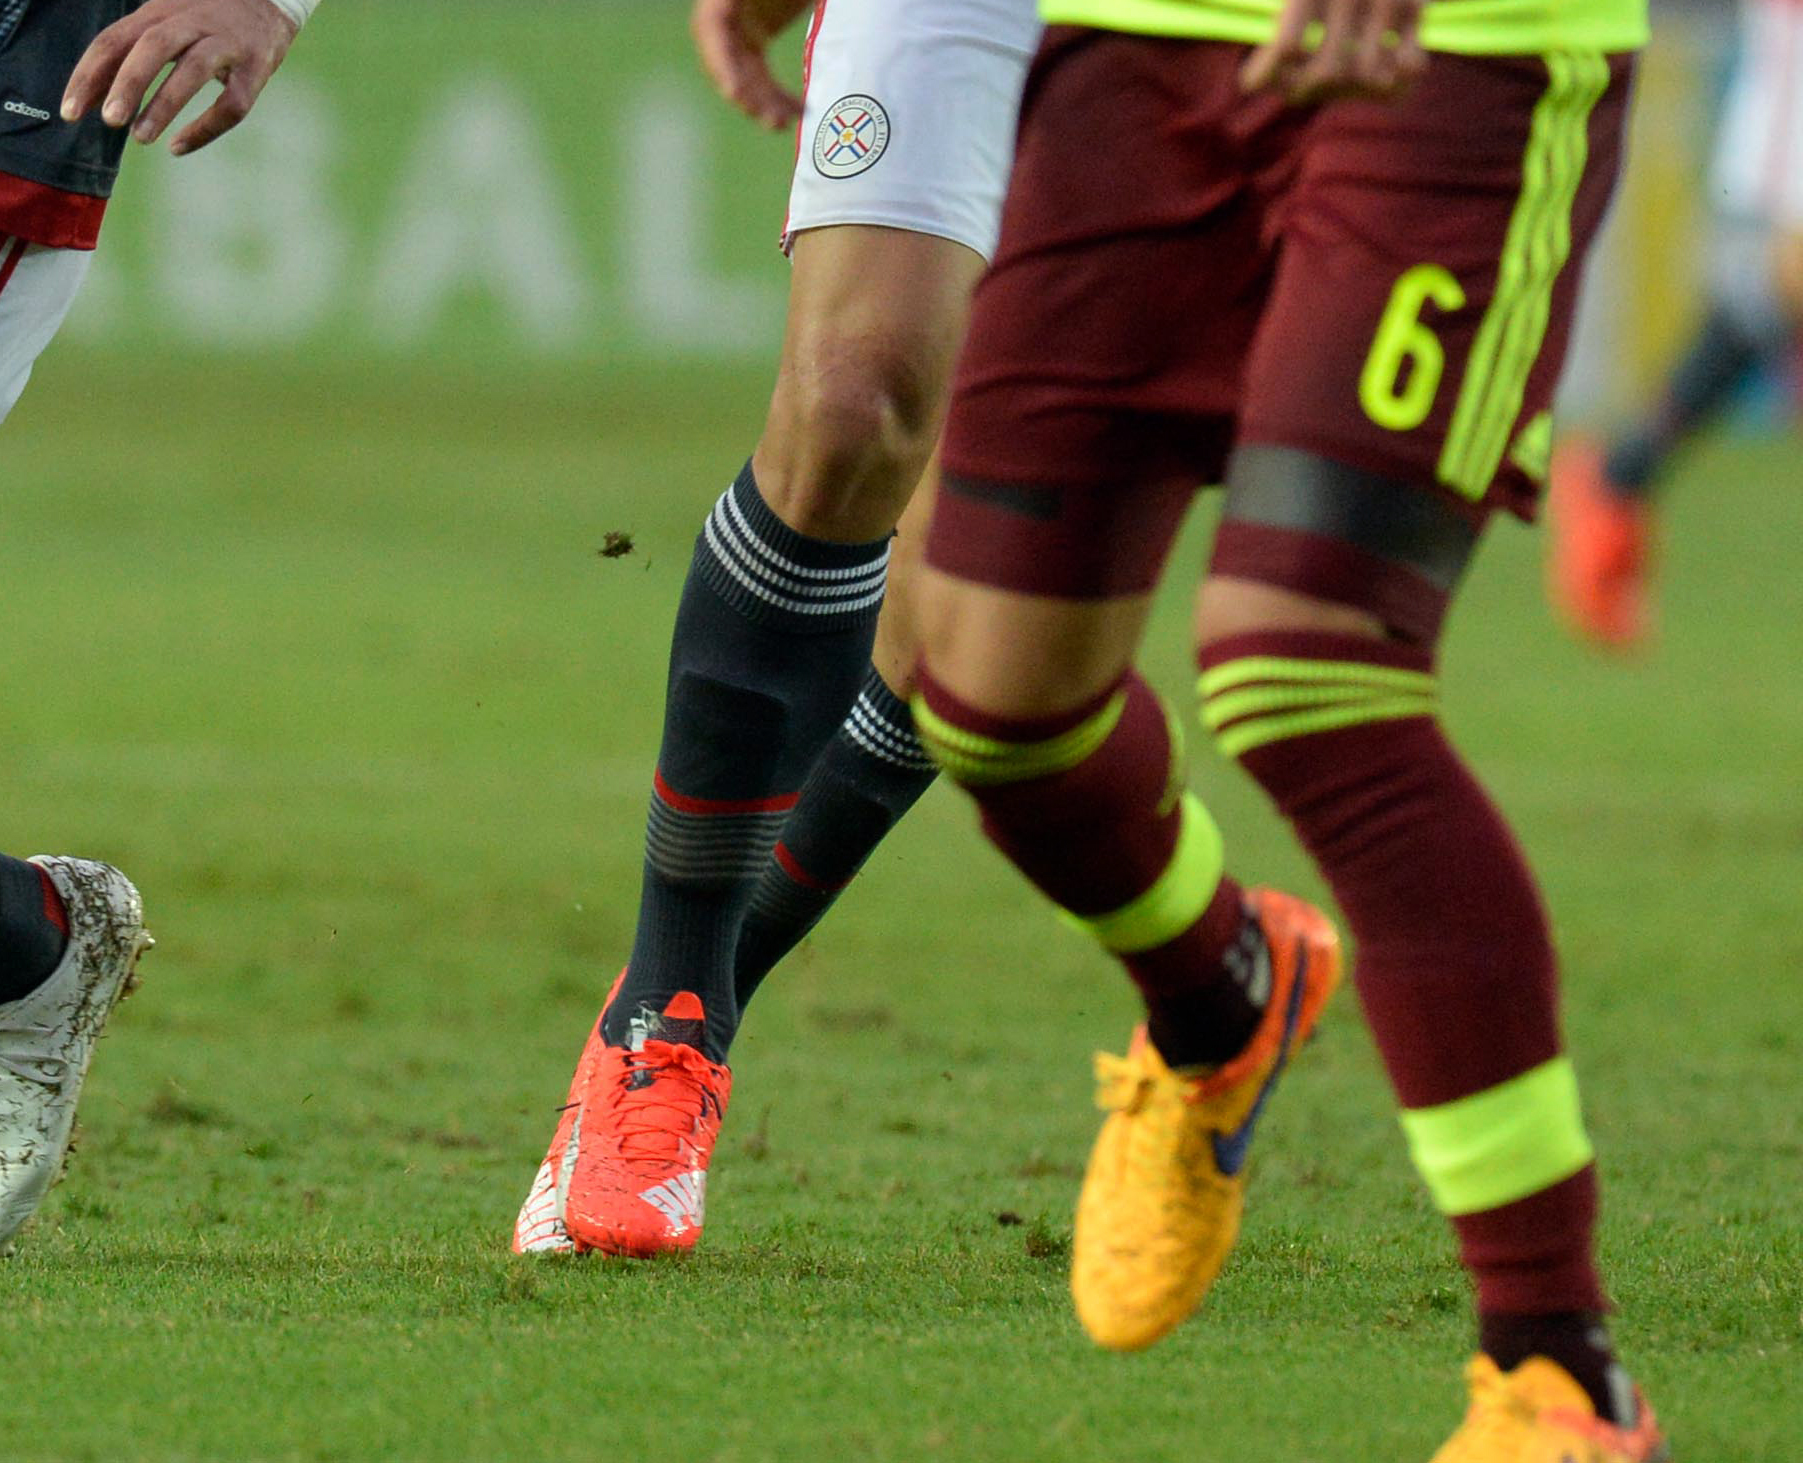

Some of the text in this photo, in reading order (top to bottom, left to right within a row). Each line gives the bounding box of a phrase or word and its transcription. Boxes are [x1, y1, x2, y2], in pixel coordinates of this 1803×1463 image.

[4, 101, 50, 120] adizero
[81, 76, 786, 341] BAL
[1358, 264, 1465, 430] 6
